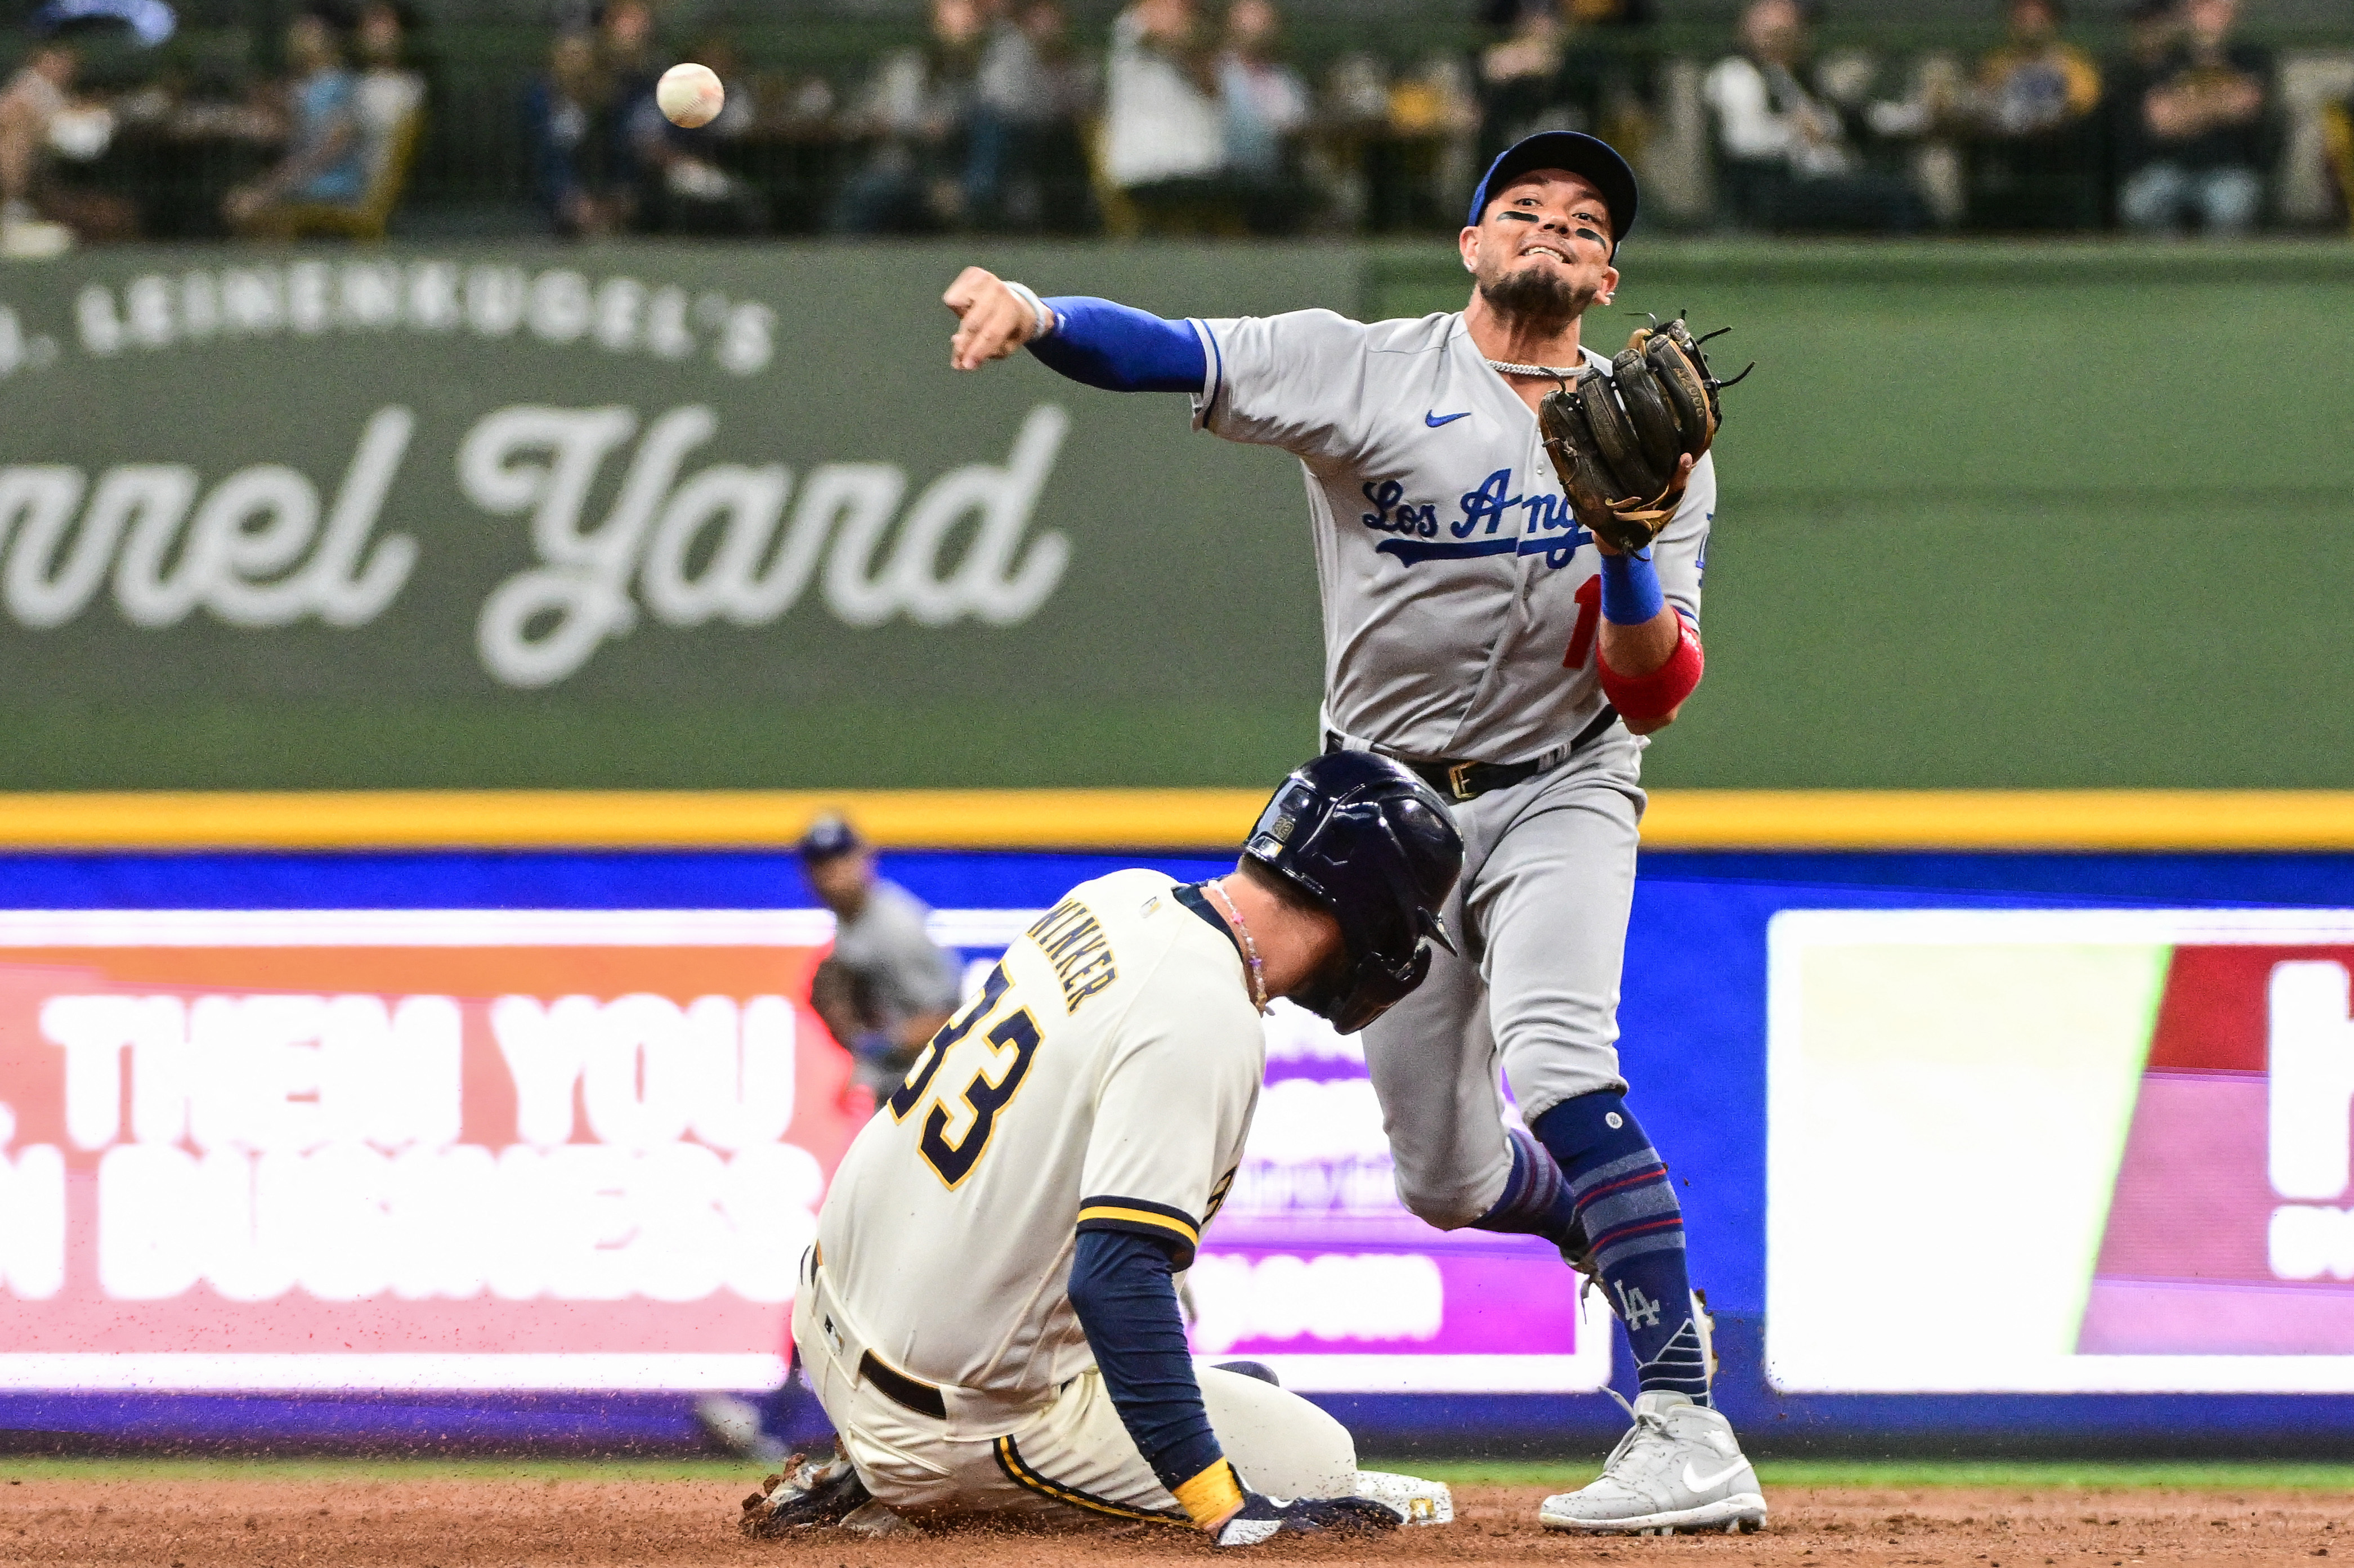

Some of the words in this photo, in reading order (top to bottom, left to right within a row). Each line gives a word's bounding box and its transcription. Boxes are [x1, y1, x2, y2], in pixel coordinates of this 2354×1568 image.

[457, 403, 1070, 687] Yard
[1361, 480, 1439, 538] Los
[490, 993, 796, 1147] YOU
[887, 958, 1045, 1191] 33
[1614, 1279, 1661, 1331] LA
